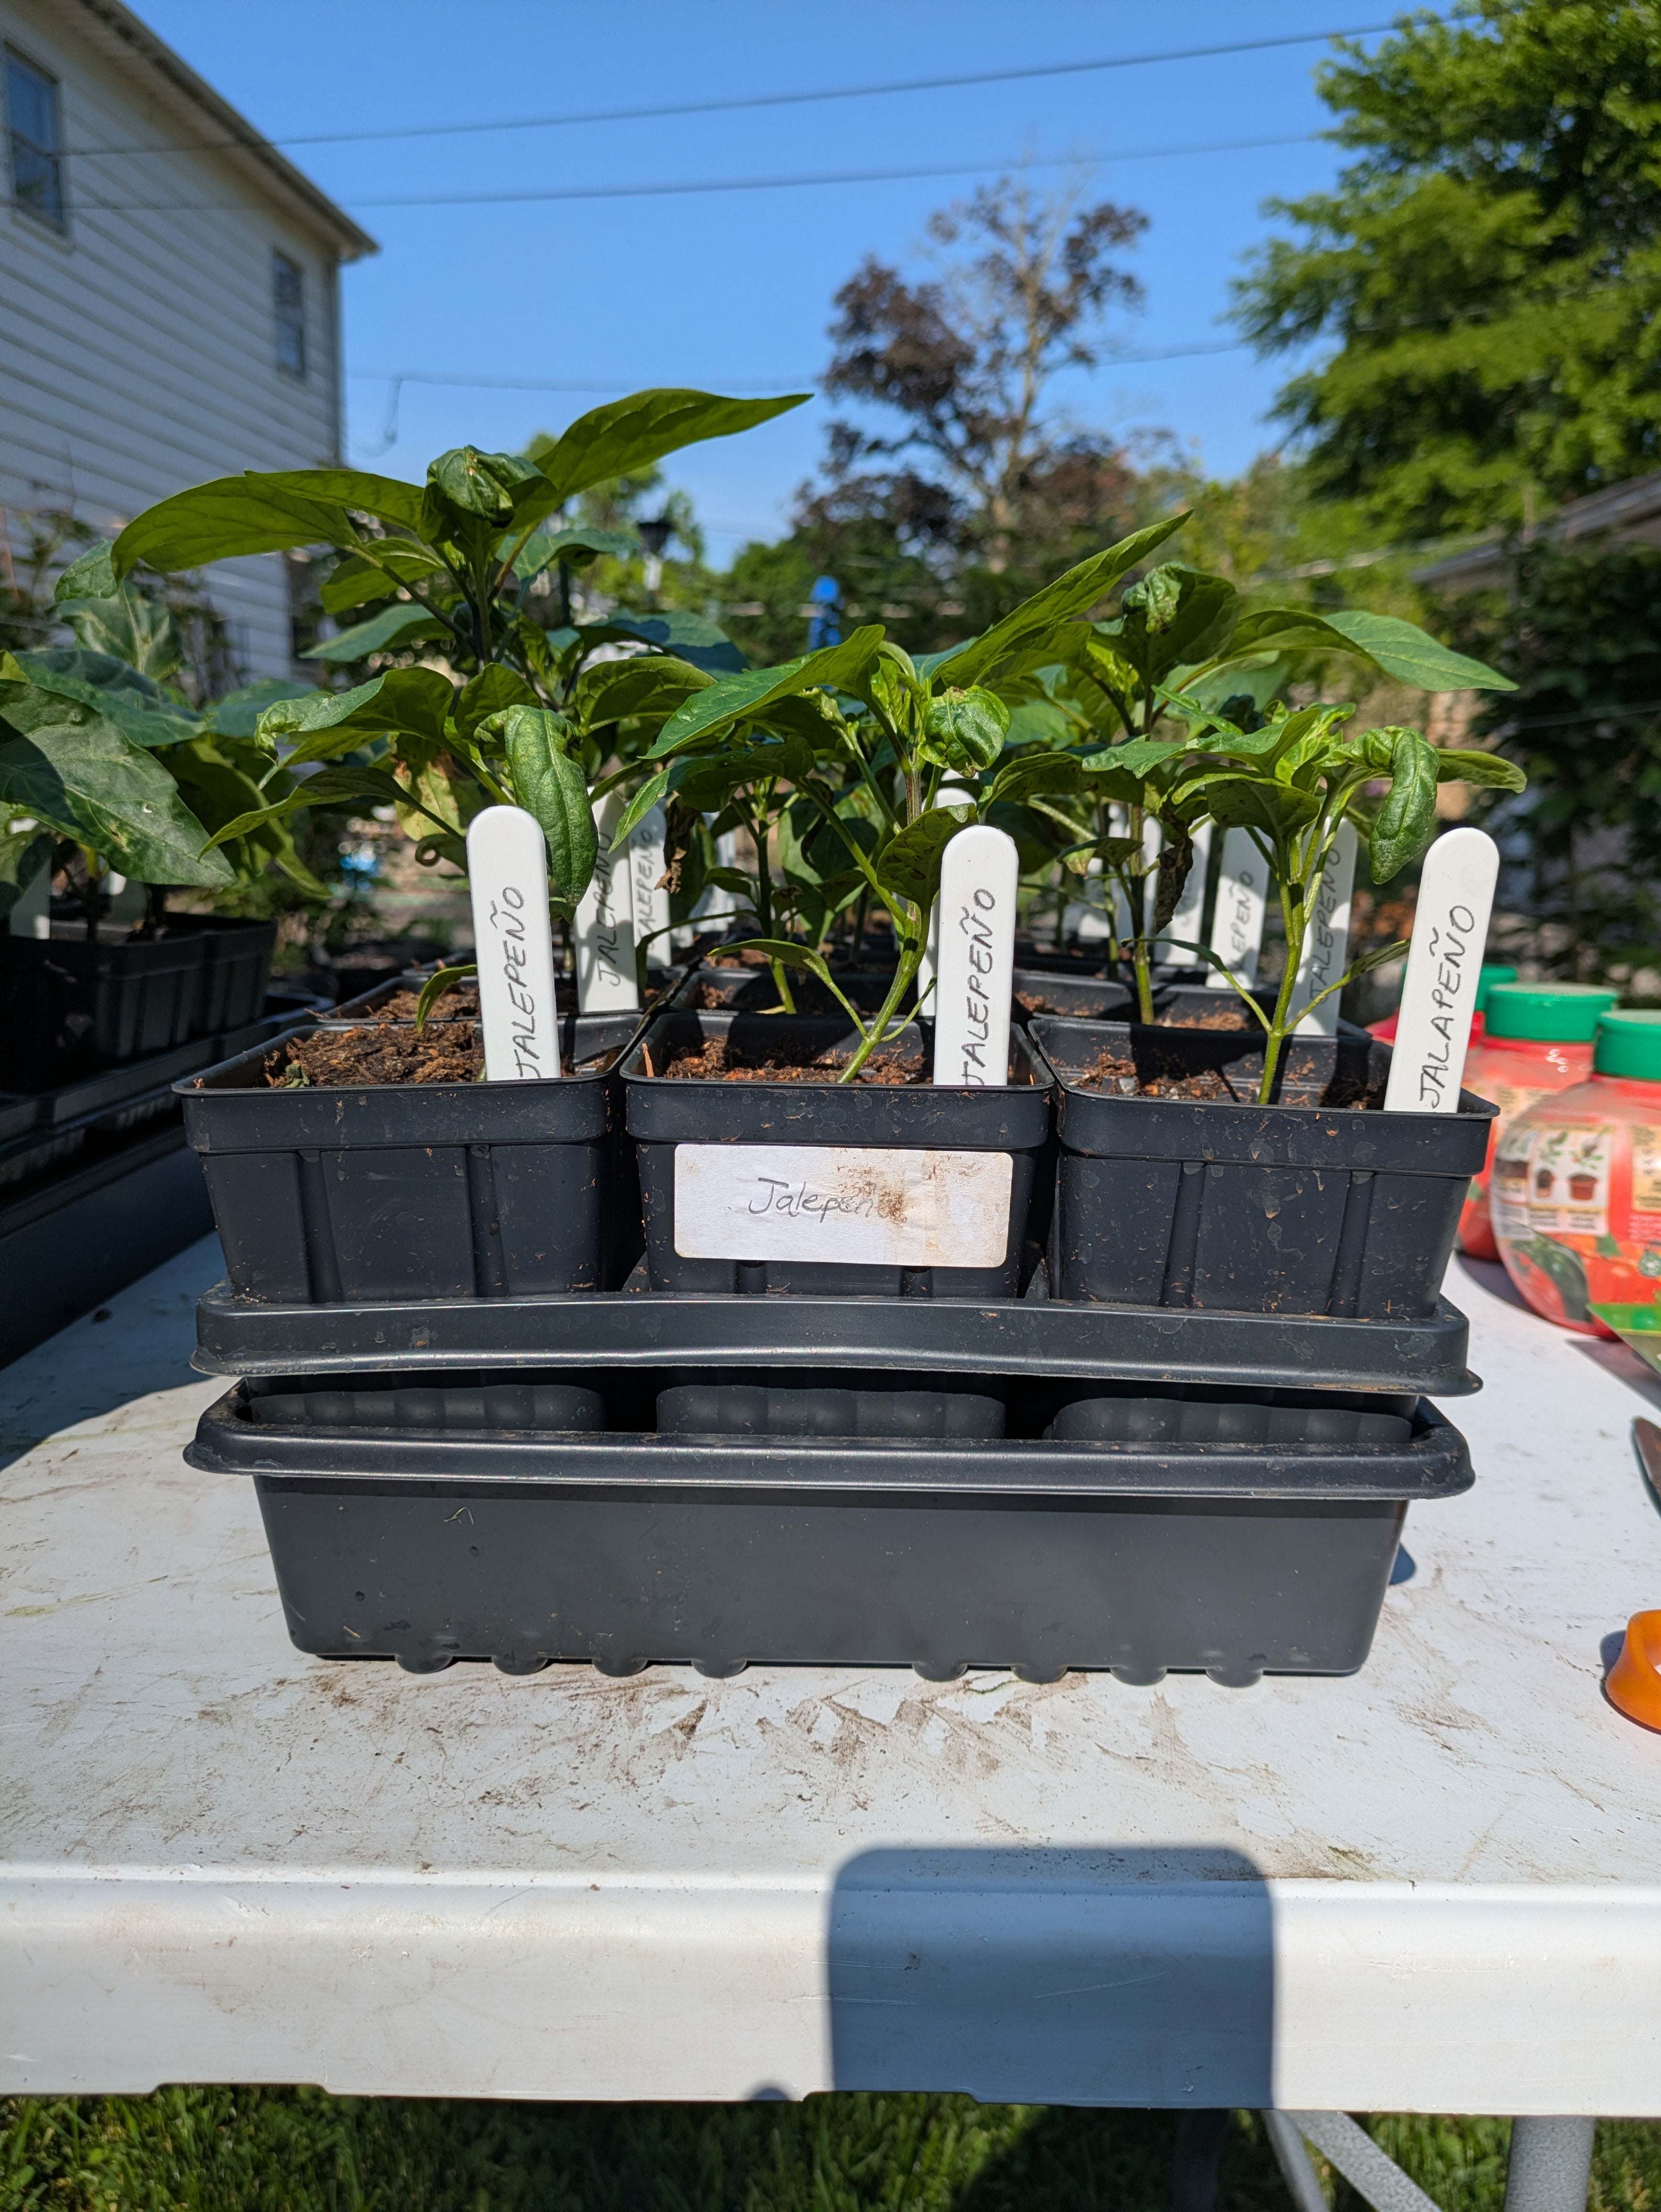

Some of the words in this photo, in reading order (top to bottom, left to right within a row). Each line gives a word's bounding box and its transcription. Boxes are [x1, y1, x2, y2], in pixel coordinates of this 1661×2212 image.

[489, 886, 542, 1079] JALEPEÑO
[958, 888, 996, 1085] JALEPEÑO
[1419, 905, 1475, 1109] JALAPEÑO
